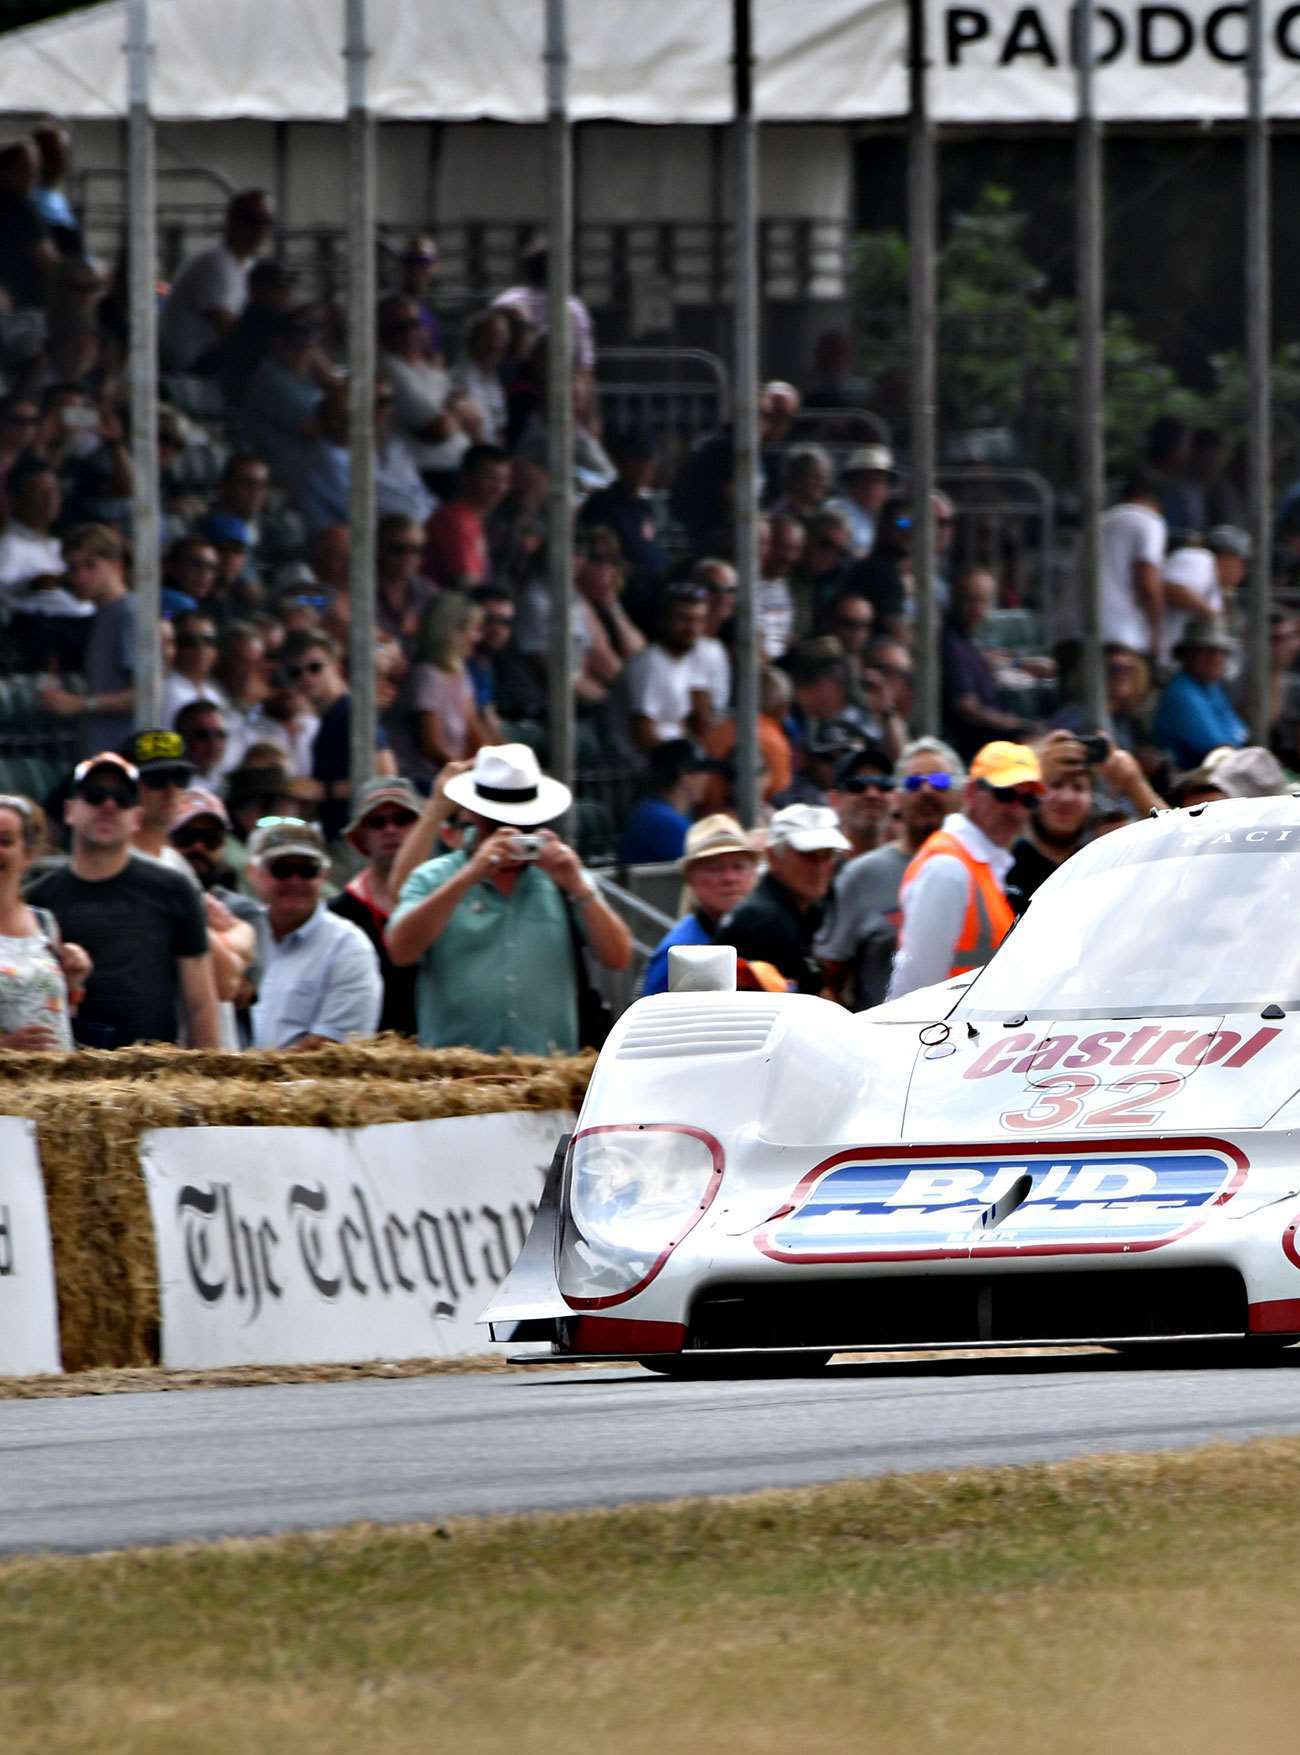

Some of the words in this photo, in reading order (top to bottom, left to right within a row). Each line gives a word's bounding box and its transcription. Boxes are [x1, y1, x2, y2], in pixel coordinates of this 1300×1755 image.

[963, 1025, 1283, 1080] Castrol
[1000, 1070, 1187, 1132] 32
[886, 1163, 1158, 1207] BUD
[177, 1182, 284, 1327] The
[288, 1180, 542, 1321] Telegra
